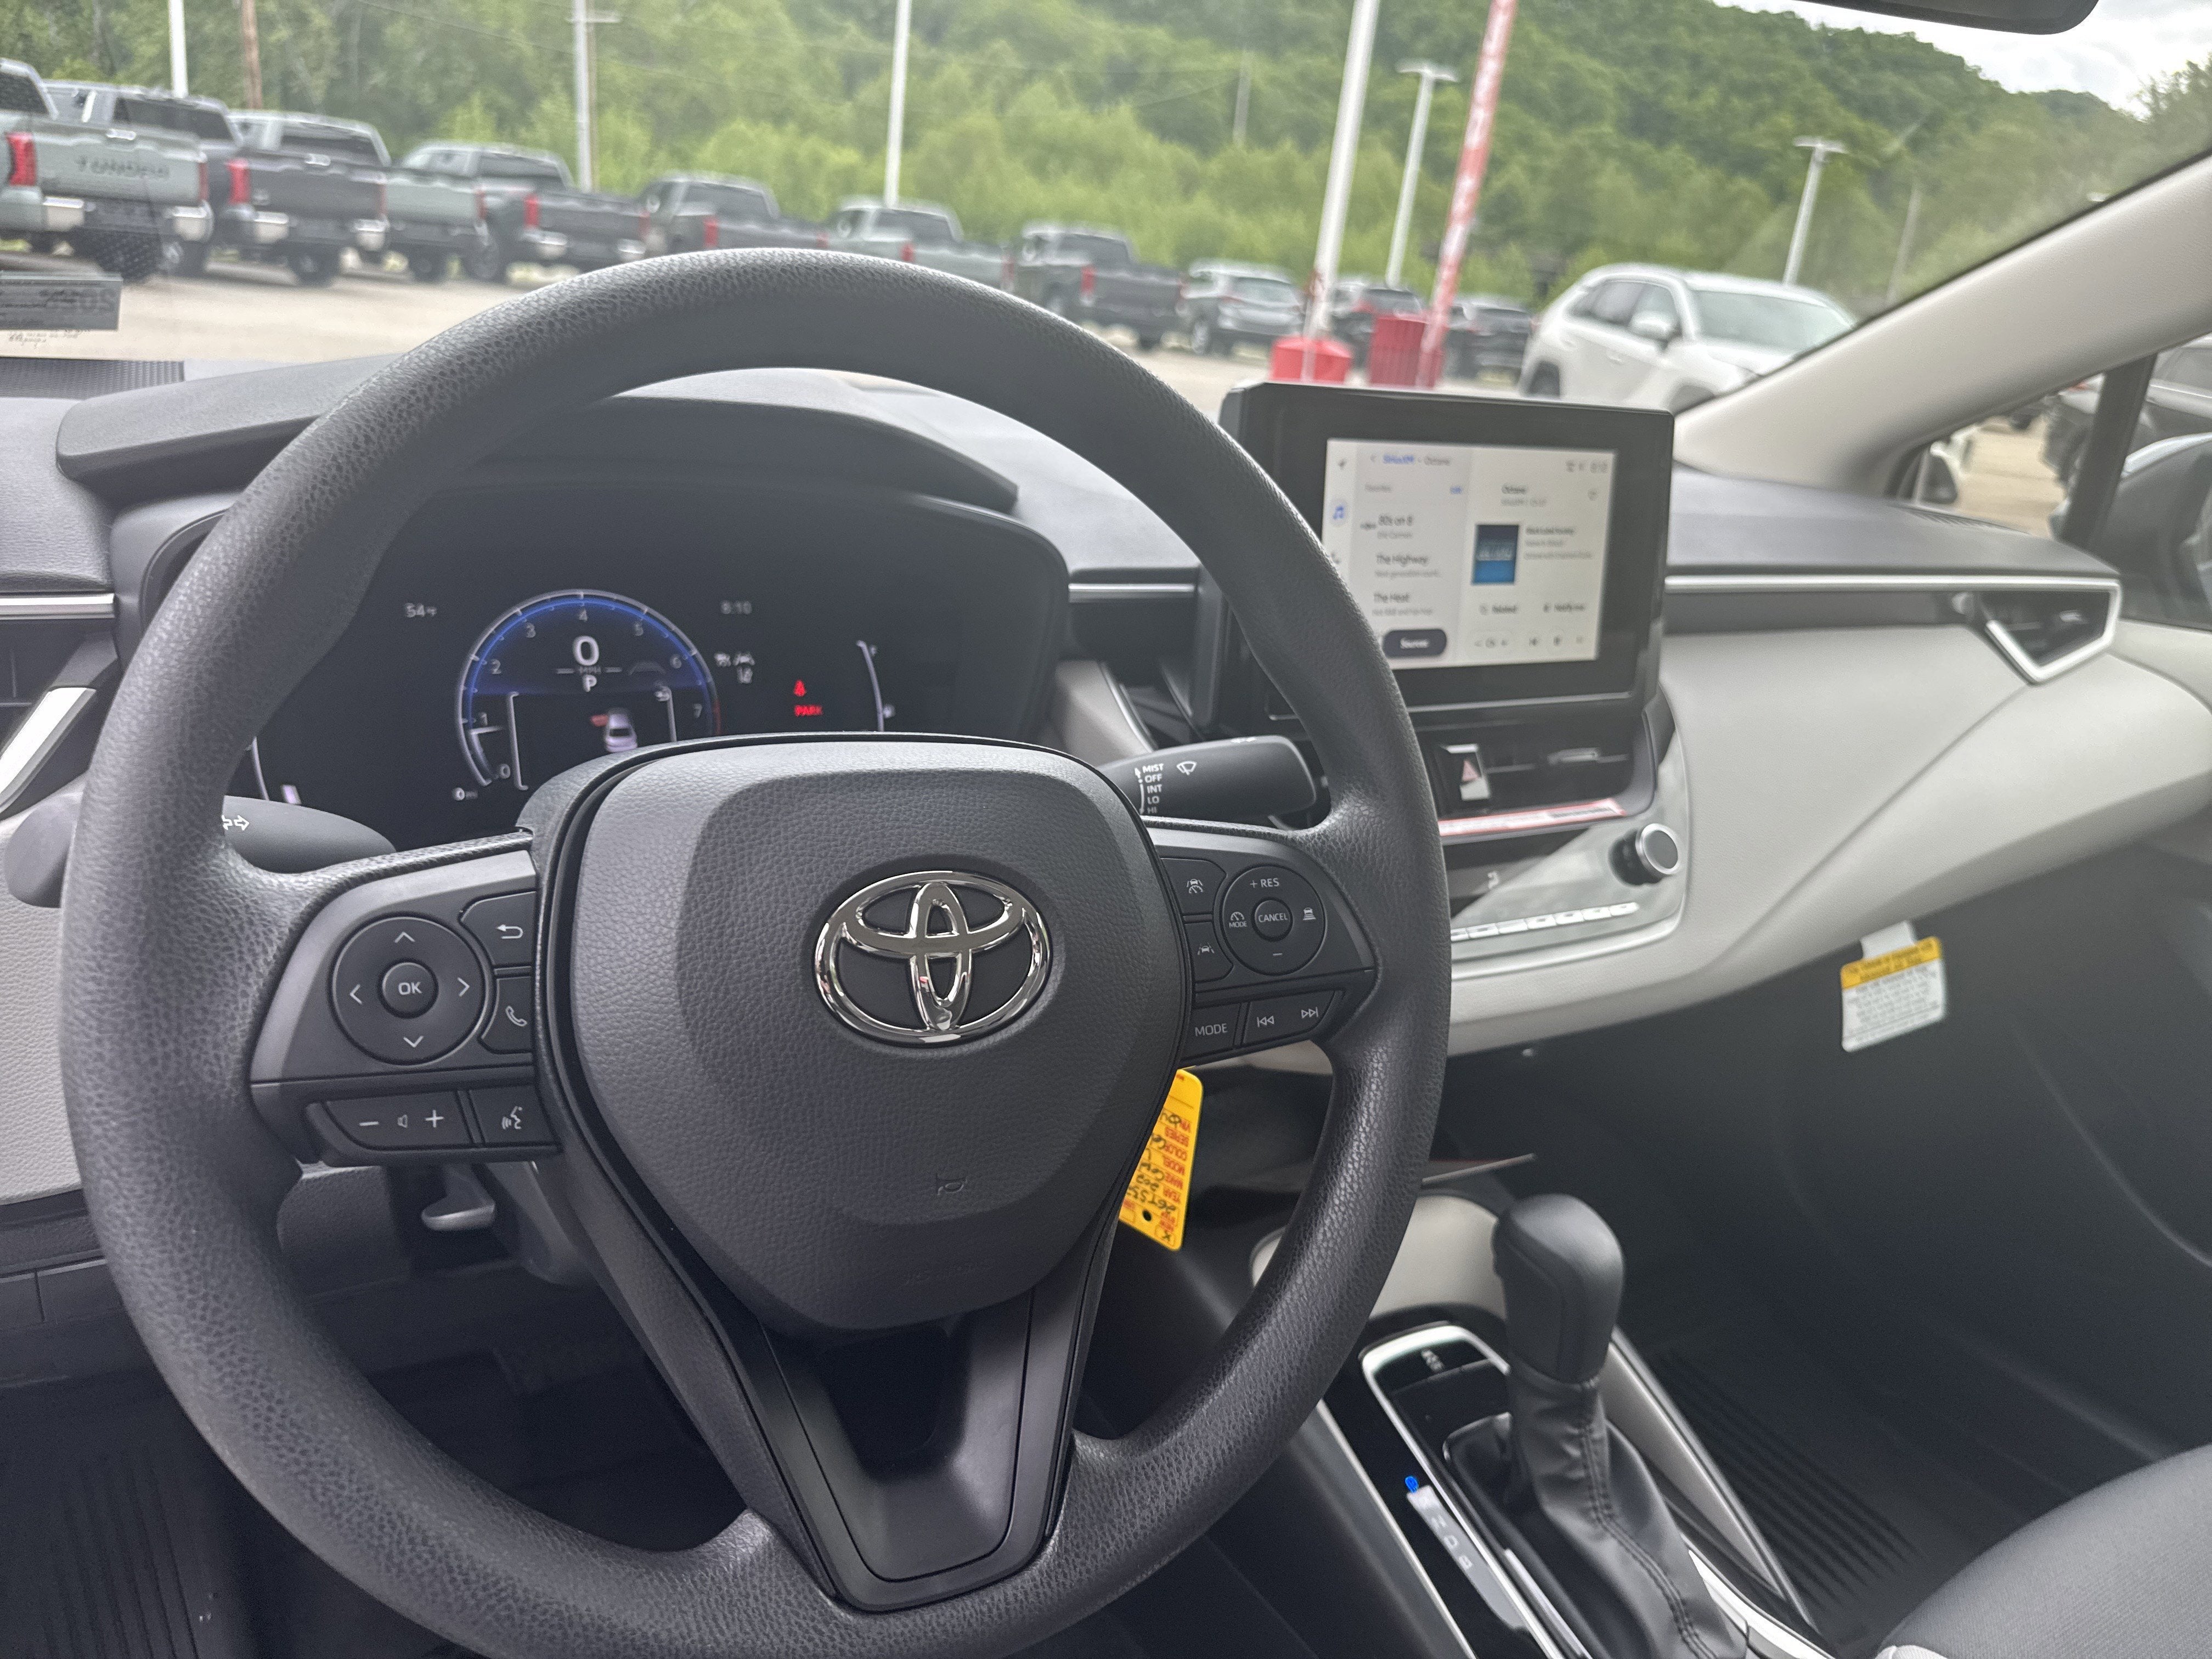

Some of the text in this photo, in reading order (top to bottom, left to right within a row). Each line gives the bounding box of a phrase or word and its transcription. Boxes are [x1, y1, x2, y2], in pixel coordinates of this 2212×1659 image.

[526, 622, 537, 639] 3
[573, 635, 600, 667] 0
[492, 658, 502, 675] 2
[669, 654, 682, 669] 6
[582, 673, 598, 693] P
[1142, 763, 1164, 774] MIST
[1144, 773, 1163, 784] OFF
[1147, 783, 1163, 794] INT
[1147, 795, 1160, 805] LO
[1147, 806, 1158, 814] HI
[1260, 877, 1280, 888] RES
[1258, 912, 1288, 923] CANCEL
[1228, 921, 1248, 929] MODE
[398, 981, 422, 996] OK
[1194, 1023, 1228, 1037] MODE
